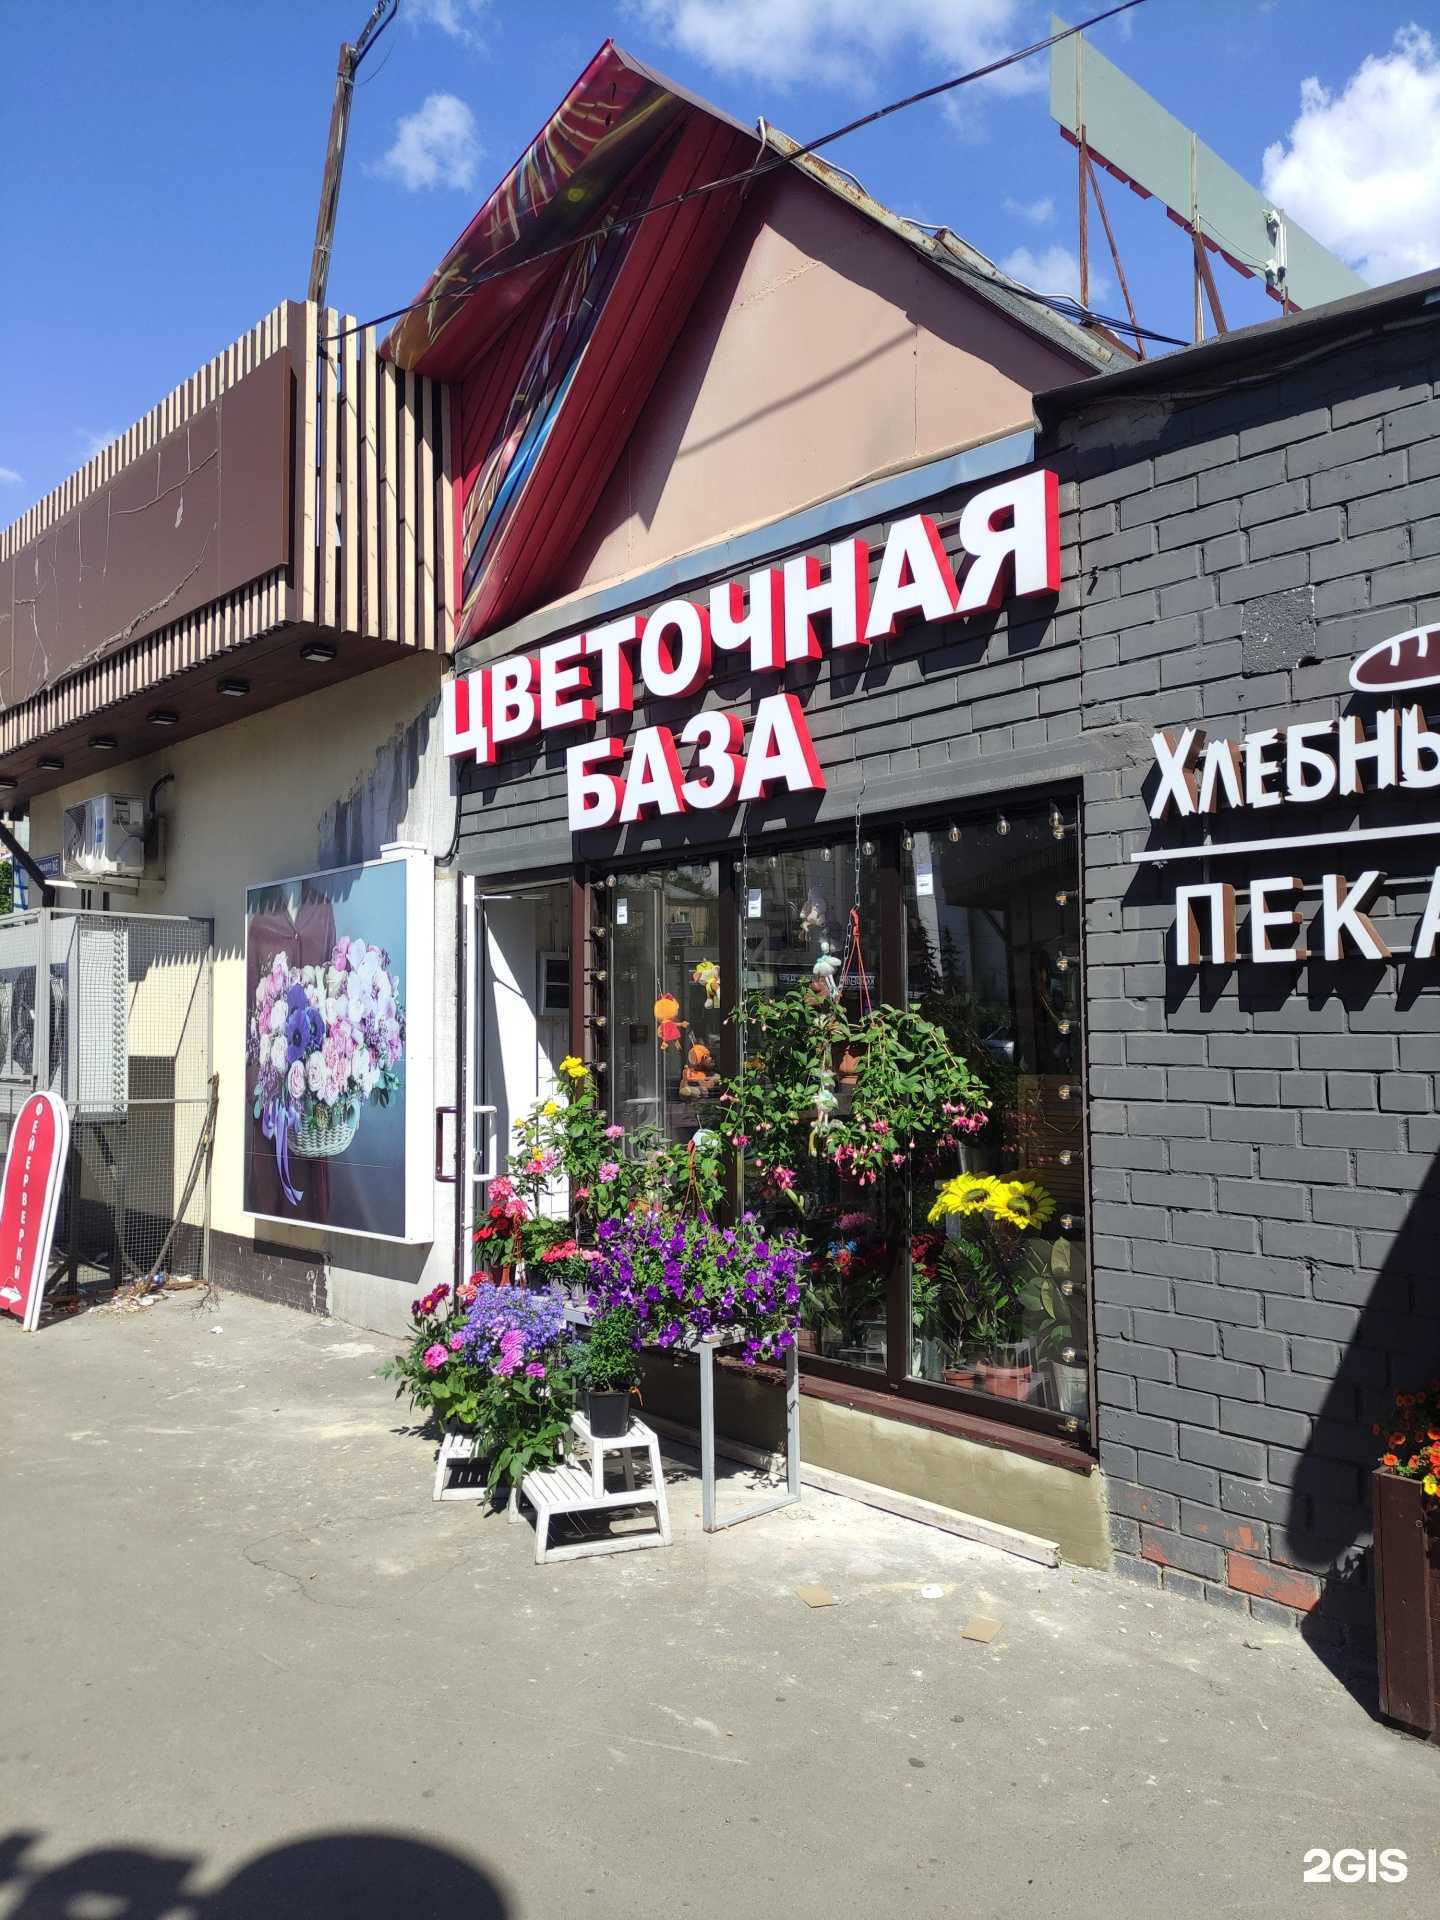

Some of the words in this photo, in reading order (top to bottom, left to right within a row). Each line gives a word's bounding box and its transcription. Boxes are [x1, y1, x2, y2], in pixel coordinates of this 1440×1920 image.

[443, 469, 1056, 763] ЦВЕТОЧНАЯ
[567, 692, 825, 832] БАЗА
[13, 1102, 44, 1280] ФЕЙЕРВЕРКИ
